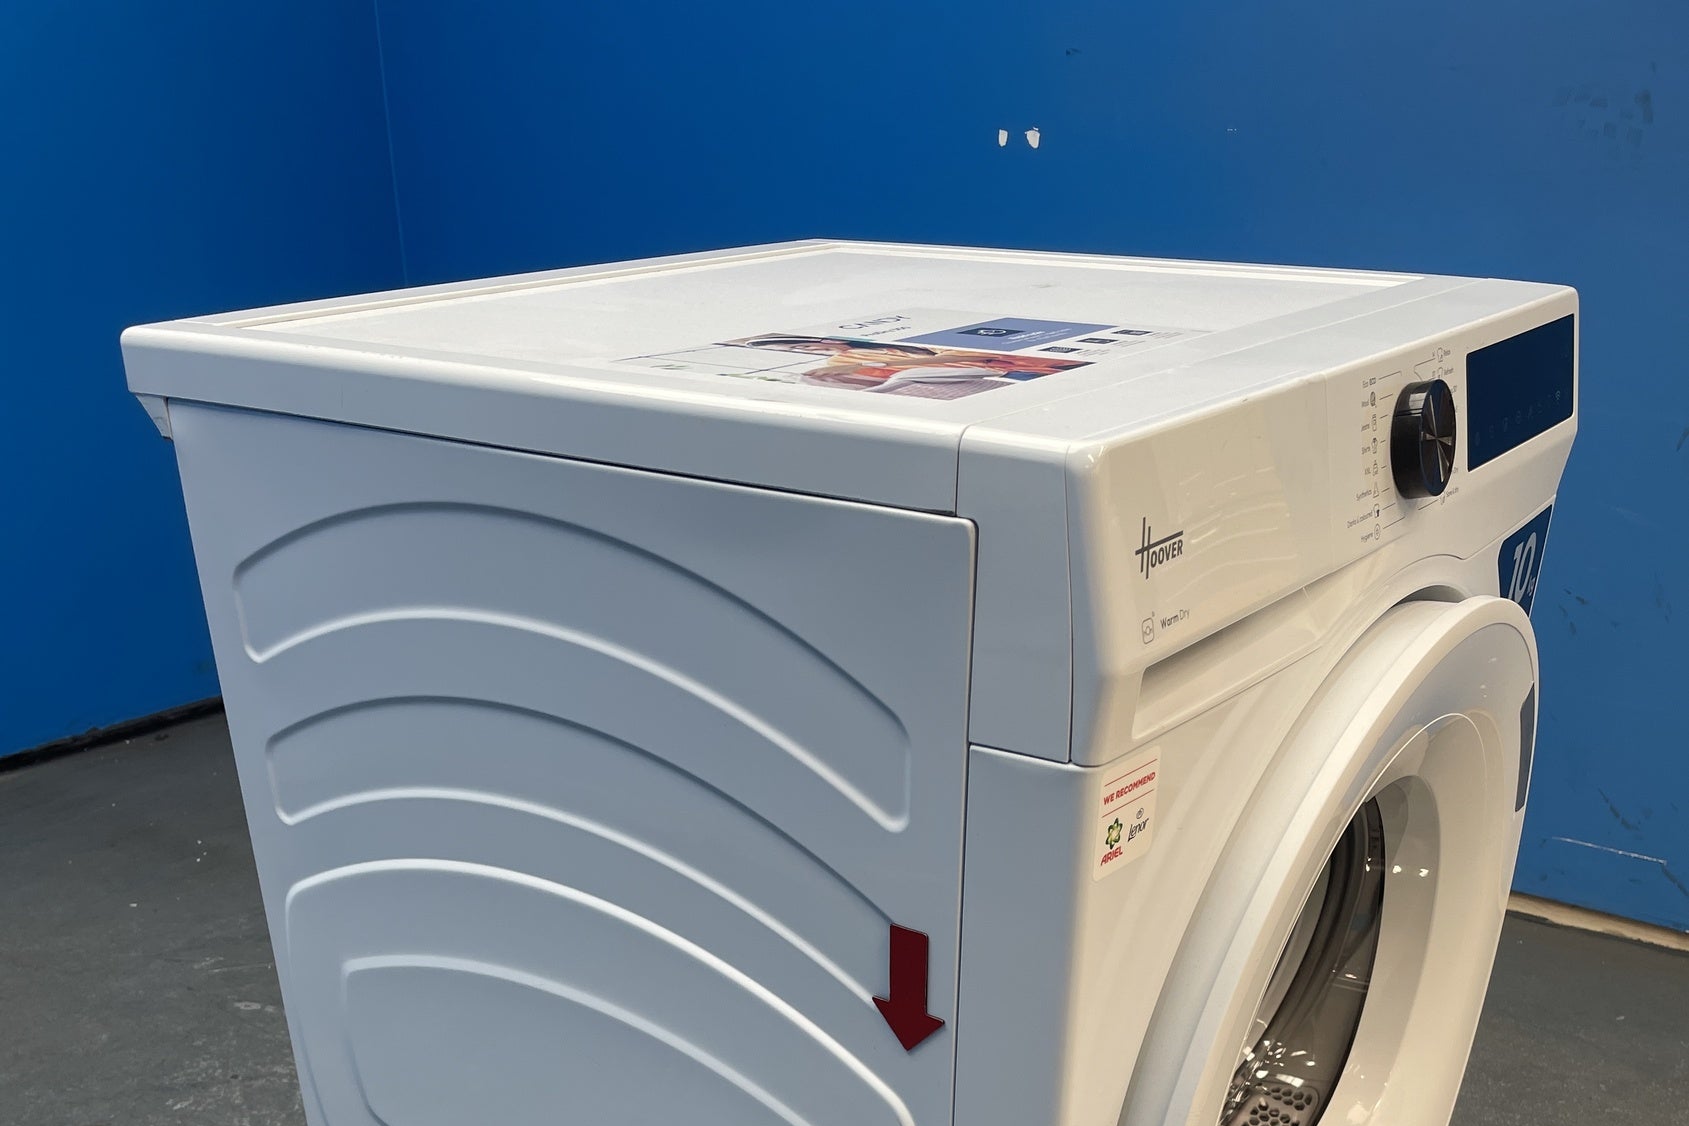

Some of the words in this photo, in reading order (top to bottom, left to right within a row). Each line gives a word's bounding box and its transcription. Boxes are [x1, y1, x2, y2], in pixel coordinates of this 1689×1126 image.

[1508, 531, 1537, 604] 10
[1160, 613, 1180, 630] Warm
[1179, 608, 1190, 622] Dry
[1103, 792, 1115, 806] WE
[1115, 771, 1156, 798] RECOMMEND
[1127, 817, 1150, 843] Lenor
[1100, 846, 1124, 866] ARIEL
